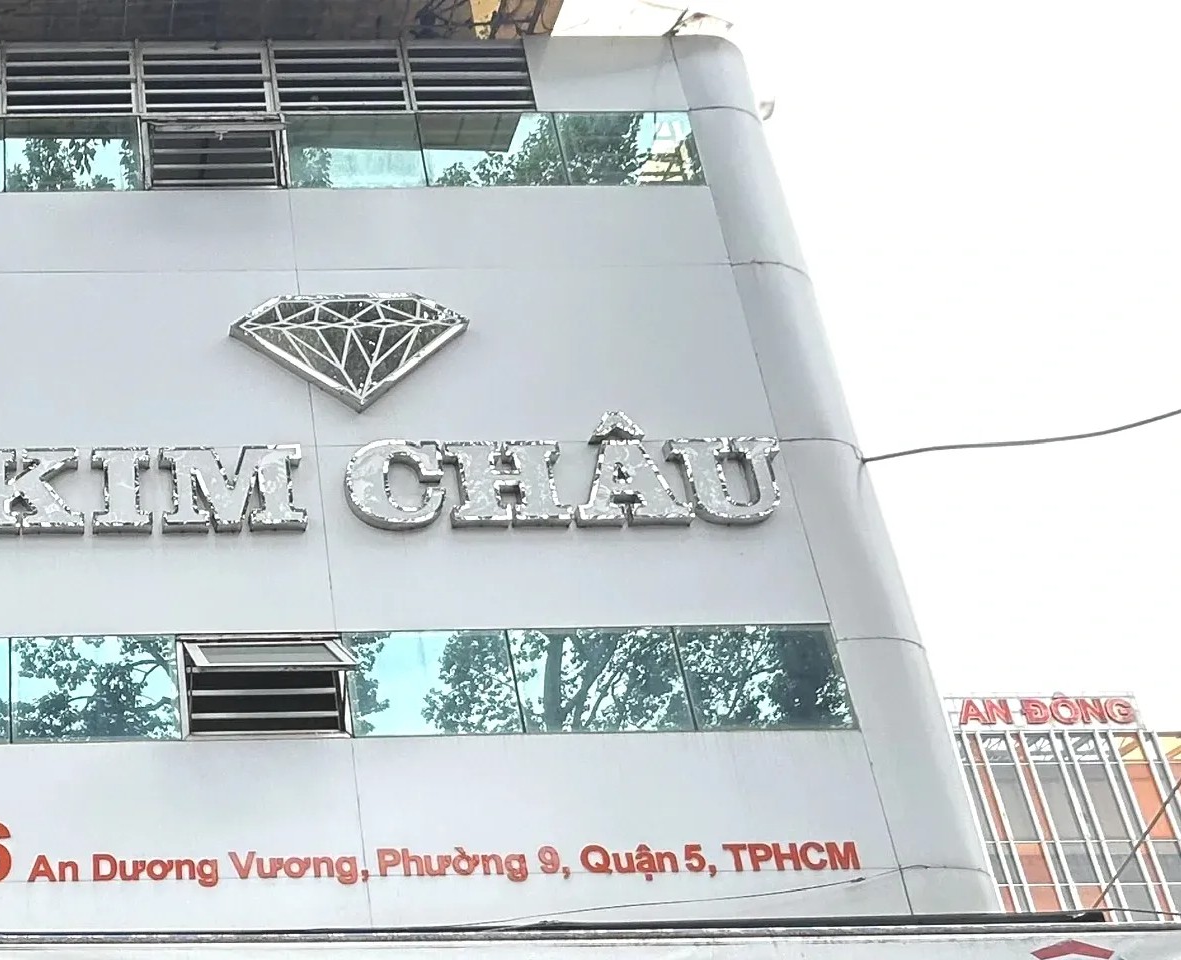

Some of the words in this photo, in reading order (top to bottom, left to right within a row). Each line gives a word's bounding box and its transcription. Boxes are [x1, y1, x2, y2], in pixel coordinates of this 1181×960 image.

[343, 410, 782, 530] CHÂU
[959, 698, 1014, 725] AN
[1020, 691, 1138, 725] ĐÔNG
[28, 854, 79, 883] An
[92, 853, 219, 887] Dương
[228, 850, 370, 885] Vương,
[376, 845, 528, 882] Phường
[537, 845, 571, 880] 9,
[579, 843, 679, 881] Quận
[684, 843, 717, 877] 5,
[722, 840, 861, 873] TPHCM
